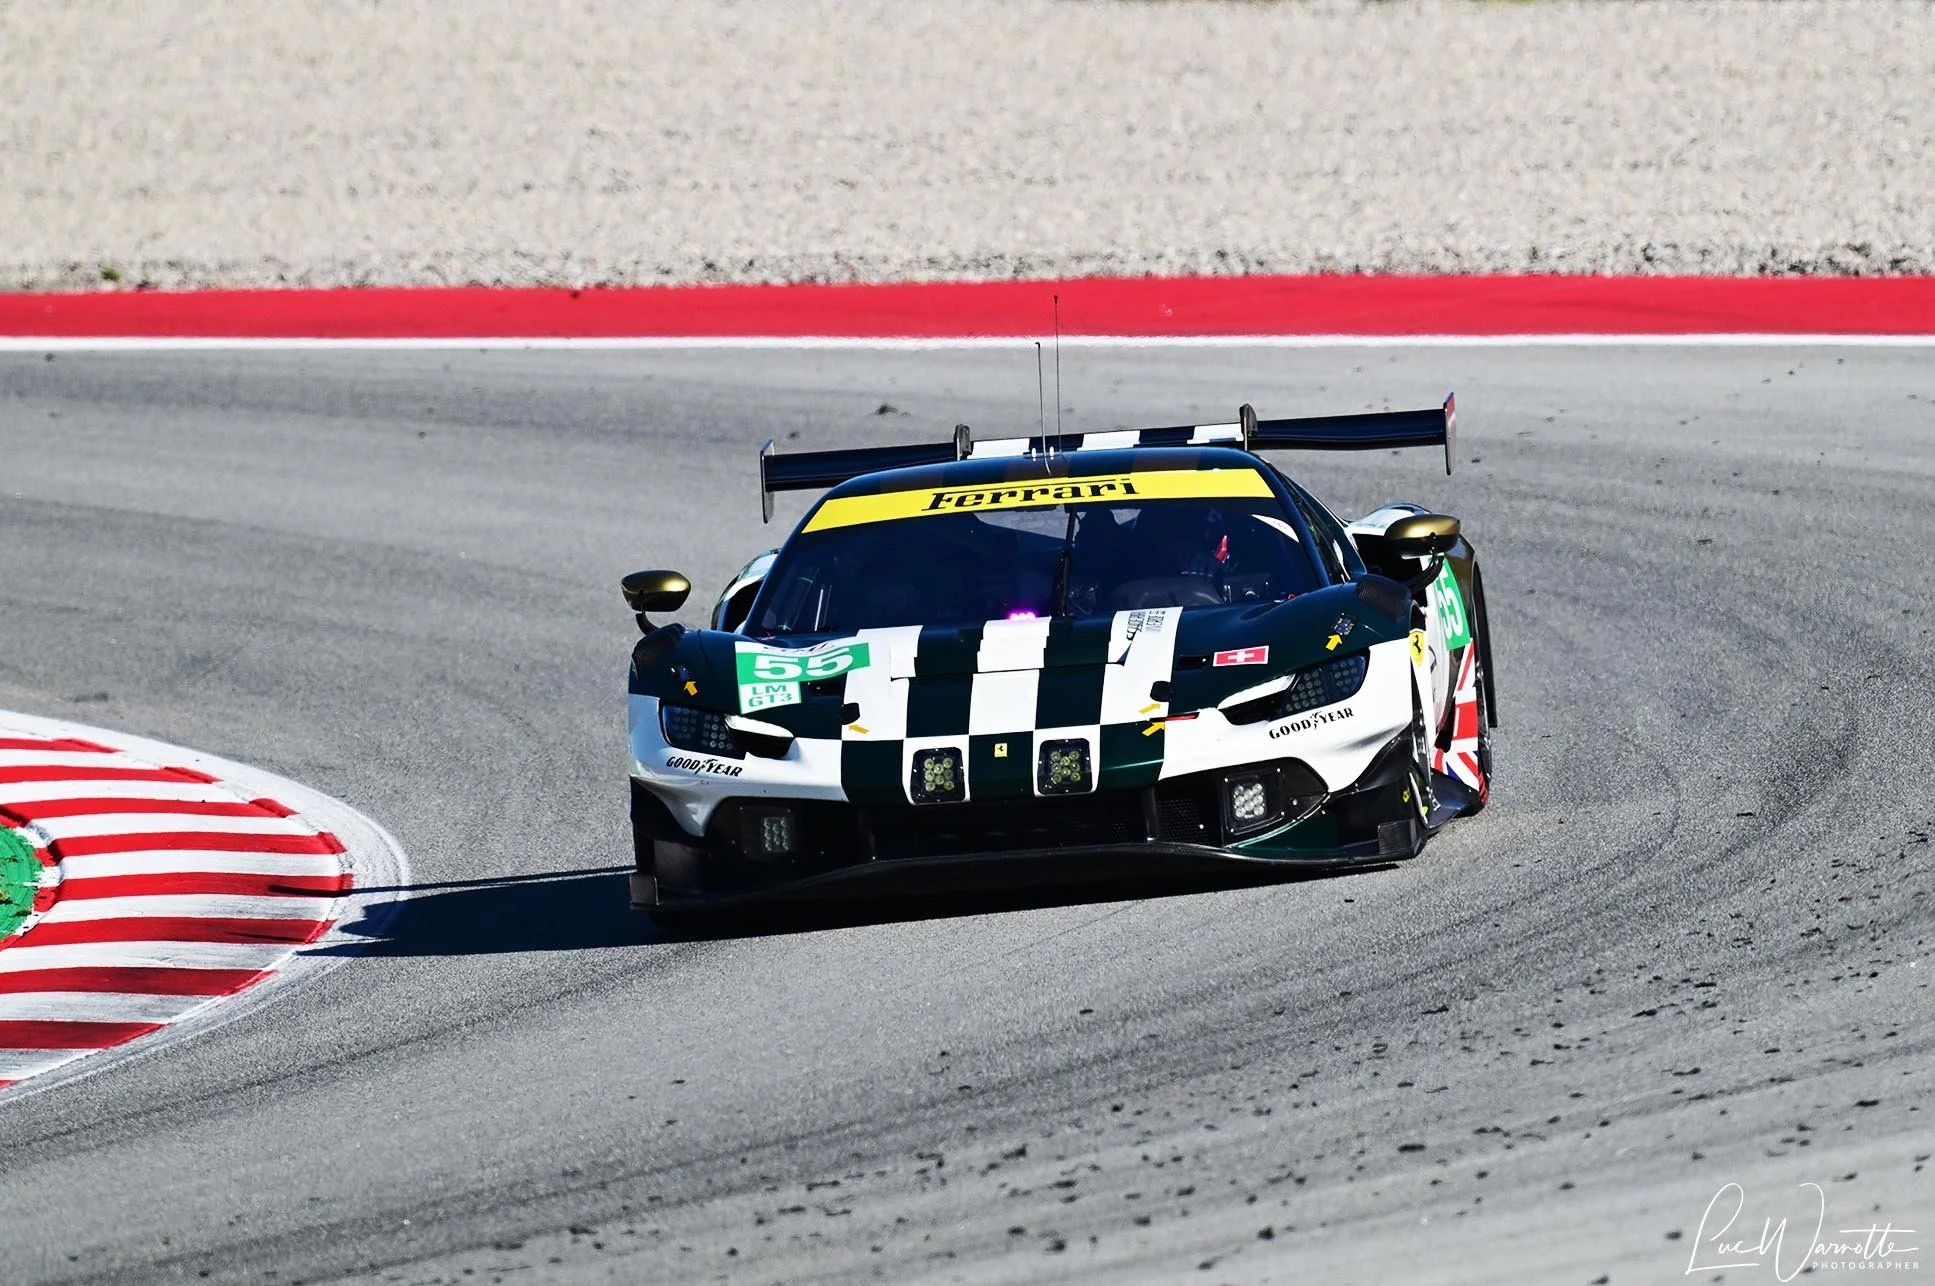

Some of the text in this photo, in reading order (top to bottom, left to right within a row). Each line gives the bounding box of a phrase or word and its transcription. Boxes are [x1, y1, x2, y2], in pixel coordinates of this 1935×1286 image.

[921, 478, 1140, 511] Ferrari
[753, 648, 854, 680] 55
[748, 693, 793, 707] GT3
[752, 684, 787, 695] LM
[1269, 707, 1354, 739] GOODYEAR
[666, 756, 743, 777] GOODYEAR
